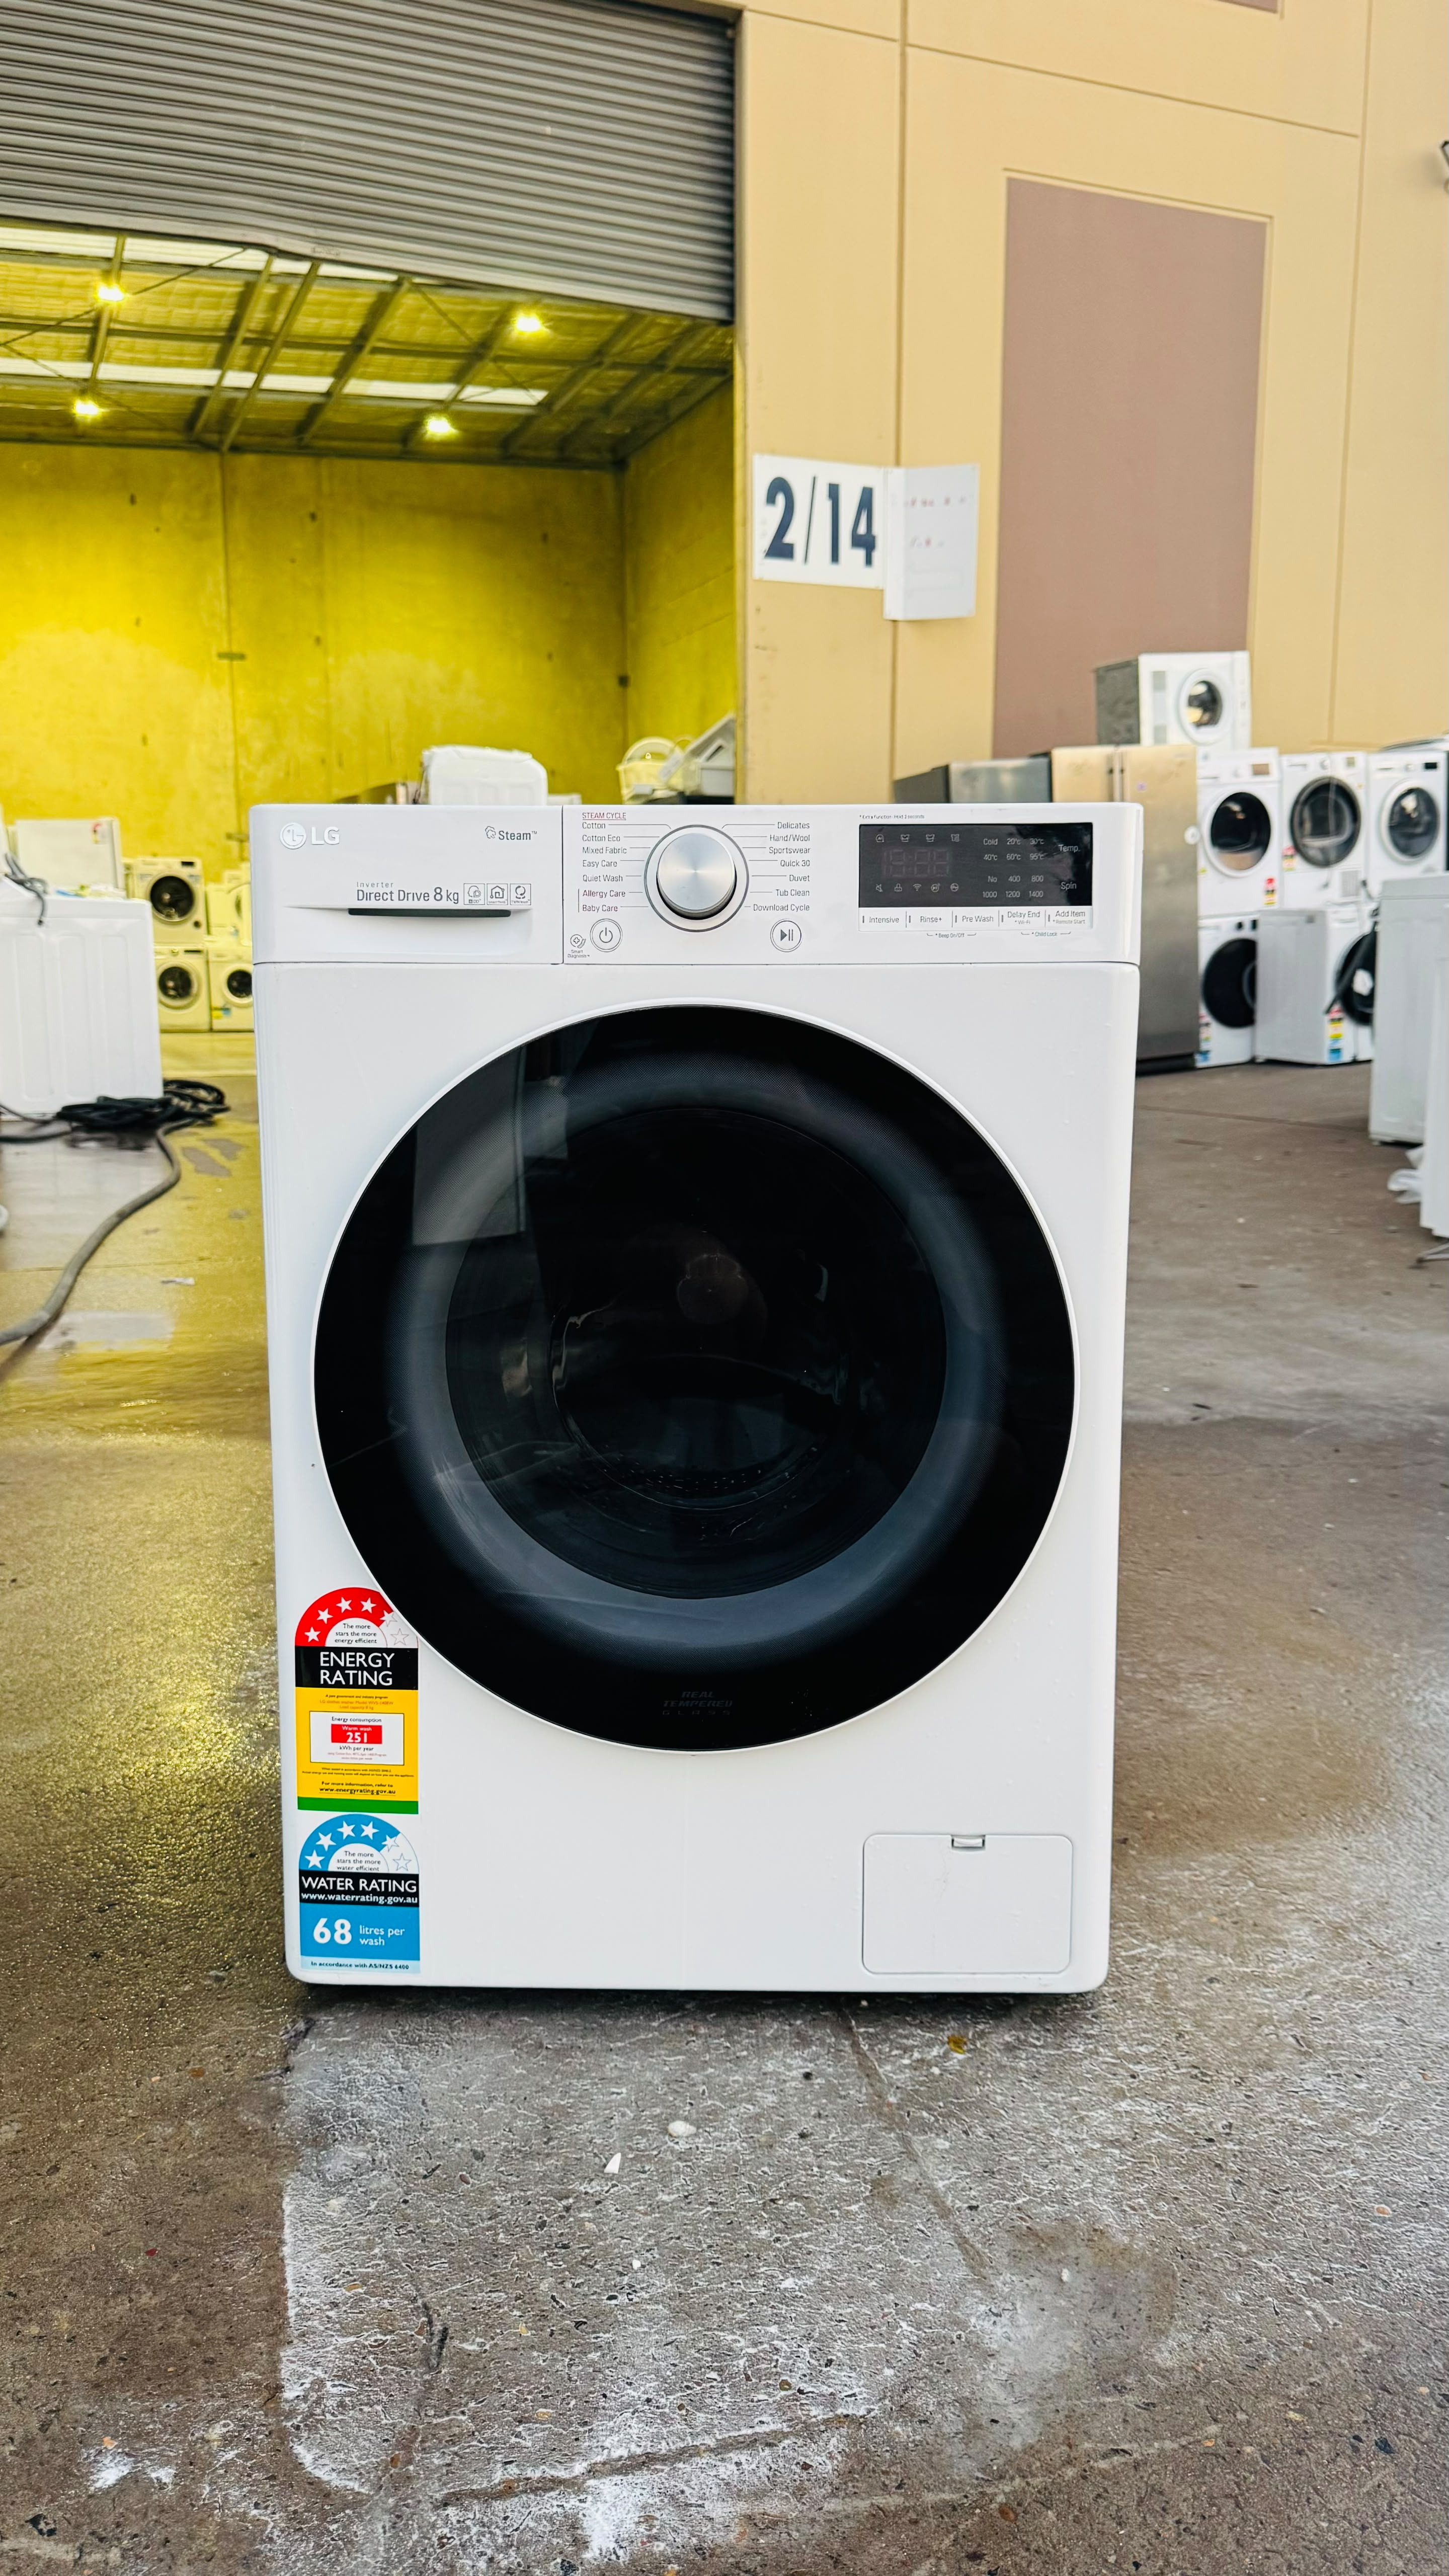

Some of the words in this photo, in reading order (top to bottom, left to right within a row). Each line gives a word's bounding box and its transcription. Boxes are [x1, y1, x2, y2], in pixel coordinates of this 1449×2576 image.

[764, 476, 876, 568] 2/14
[311, 826, 340, 845] LG
[769, 846, 811, 855] Sportswear
[1058, 844, 1081, 853] Temp.
[583, 860, 599, 869] Easy
[780, 859, 800, 867] Quick
[583, 874, 601, 882] Quiet
[1061, 882, 1077, 891] Spin
[357, 890, 394, 902] Direct
[398, 890, 430, 902] Drive
[433, 887, 443, 901] 8
[446, 890, 459, 904] kg
[583, 890, 607, 899] Allergy
[582, 904, 600, 913] Baby
[790, 904, 810, 913] Cycle
[320, 1652, 395, 1668] ENERGY
[320, 1669, 393, 1686] RATING
[346, 1732, 367, 1743] 251
[319, 1787, 396, 1795] www.energyrating.gov.au
[301, 1876, 355, 1891] WATER
[359, 1879, 417, 1893] RATING
[301, 1892, 418, 1904] www.waterrating.gov.au
[313, 1917, 352, 1945] 68
[359, 1925, 384, 1935] litres
[387, 1928, 405, 1938] per
[359, 1937, 385, 1946] wash
